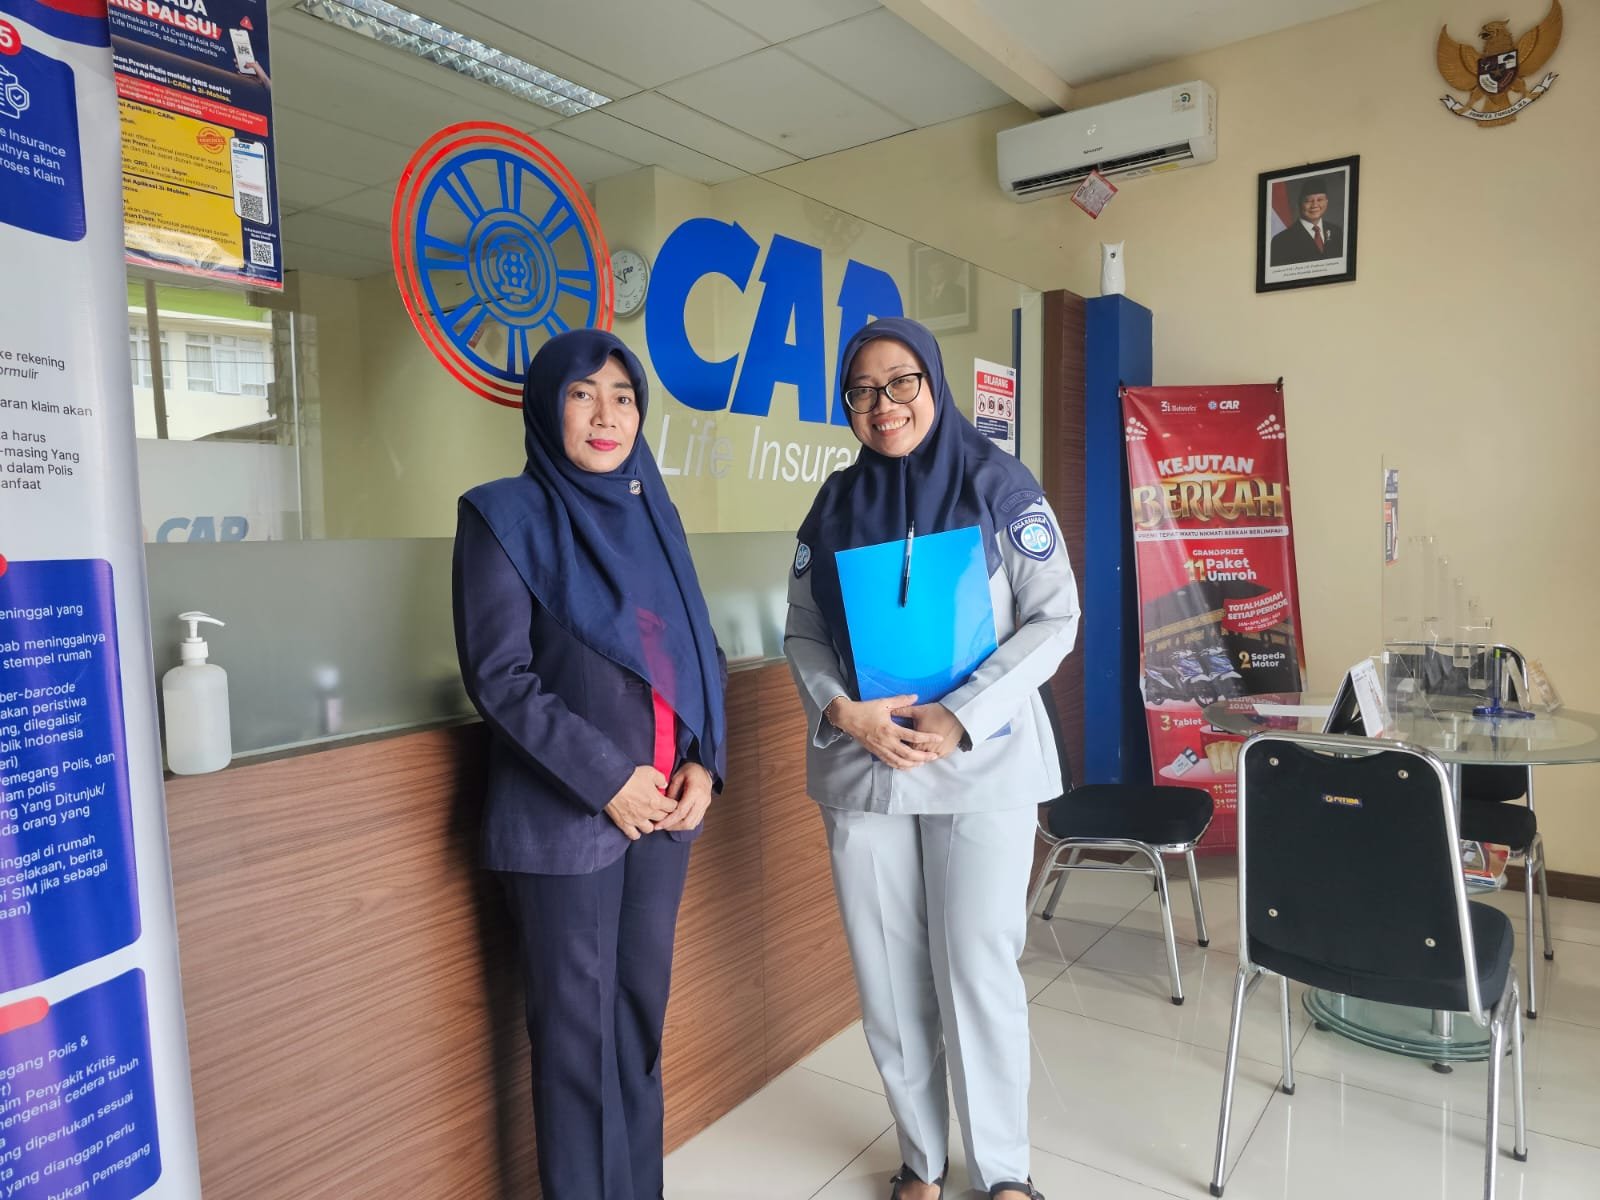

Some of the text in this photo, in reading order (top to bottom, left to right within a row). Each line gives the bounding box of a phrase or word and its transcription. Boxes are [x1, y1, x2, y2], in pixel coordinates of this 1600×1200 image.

[112, 17, 125, 27] Life
[147, 0, 217, 38] PALSU!
[0, 25, 13, 48] 5
[9, 128, 66, 157] Insurance
[33, 154, 60, 170] akan
[33, 167, 65, 186] Klaim
[16, 352, 65, 371] rekening
[0, 398, 93, 417] aran klaim akan
[1219, 400, 1240, 410] CAR
[12, 430, 47, 443] harus
[51, 448, 80, 463] Yang
[659, 414, 861, 483] Life Insura
[6, 462, 73, 476] dalam Polis
[1157, 455, 1255, 477] KEJUTAN
[1, 478, 42, 490] anfaat
[1133, 478, 1284, 528] BERKAH
[1206, 557, 1250, 570] Paket
[1207, 569, 1256, 582] Umroh
[1228, 591, 1284, 612] TOTAL HADIAH
[1228, 611, 1256, 620] SETIAP
[1256, 598, 1289, 616] PERIODE
[0, 604, 83, 621] eninggal yang
[24, 632, 105, 650] meninggalnya
[3, 649, 92, 669] stempel rumah
[1239, 651, 1286, 668] 2 Sepeda
[1252, 660, 1280, 668] Motor
[0, 682, 76, 703] ber-barcode
[0, 696, 87, 720] akan peristiwa
[24, 711, 82, 732] dilegalisir
[1160, 715, 1202, 731] 3 Tablet
[1, 727, 84, 753] blik Indonesia
[0, 752, 115, 786] emegang Polis, dan
[21, 799, 52, 815] Yang
[55, 782, 105, 803] Ditunjuk/
[27, 780, 57, 800] polis
[1, 805, 90, 836] da orang yang
[0, 833, 96, 869] inggal di rumah
[69, 848, 104, 866] berita
[11, 882, 38, 900] SIM
[40, 877, 60, 895] jika
[63, 860, 108, 884] sebagai
[0, 901, 31, 920] aan)
[48, 1041, 78, 1063] Polis
[80, 1034, 89, 1048] &
[0, 1082, 11, 1097] t)
[26, 1070, 84, 1104] Penyakit
[86, 1054, 116, 1078] Kritis
[65, 1074, 105, 1103] cedera
[108, 1057, 139, 1081] tubuh
[25, 1113, 95, 1151] diperlukan
[97, 1090, 134, 1118] sesuai
[6, 1121, 136, 1198] yang dianggap perlu
[92, 1142, 151, 1185] Pemegang
